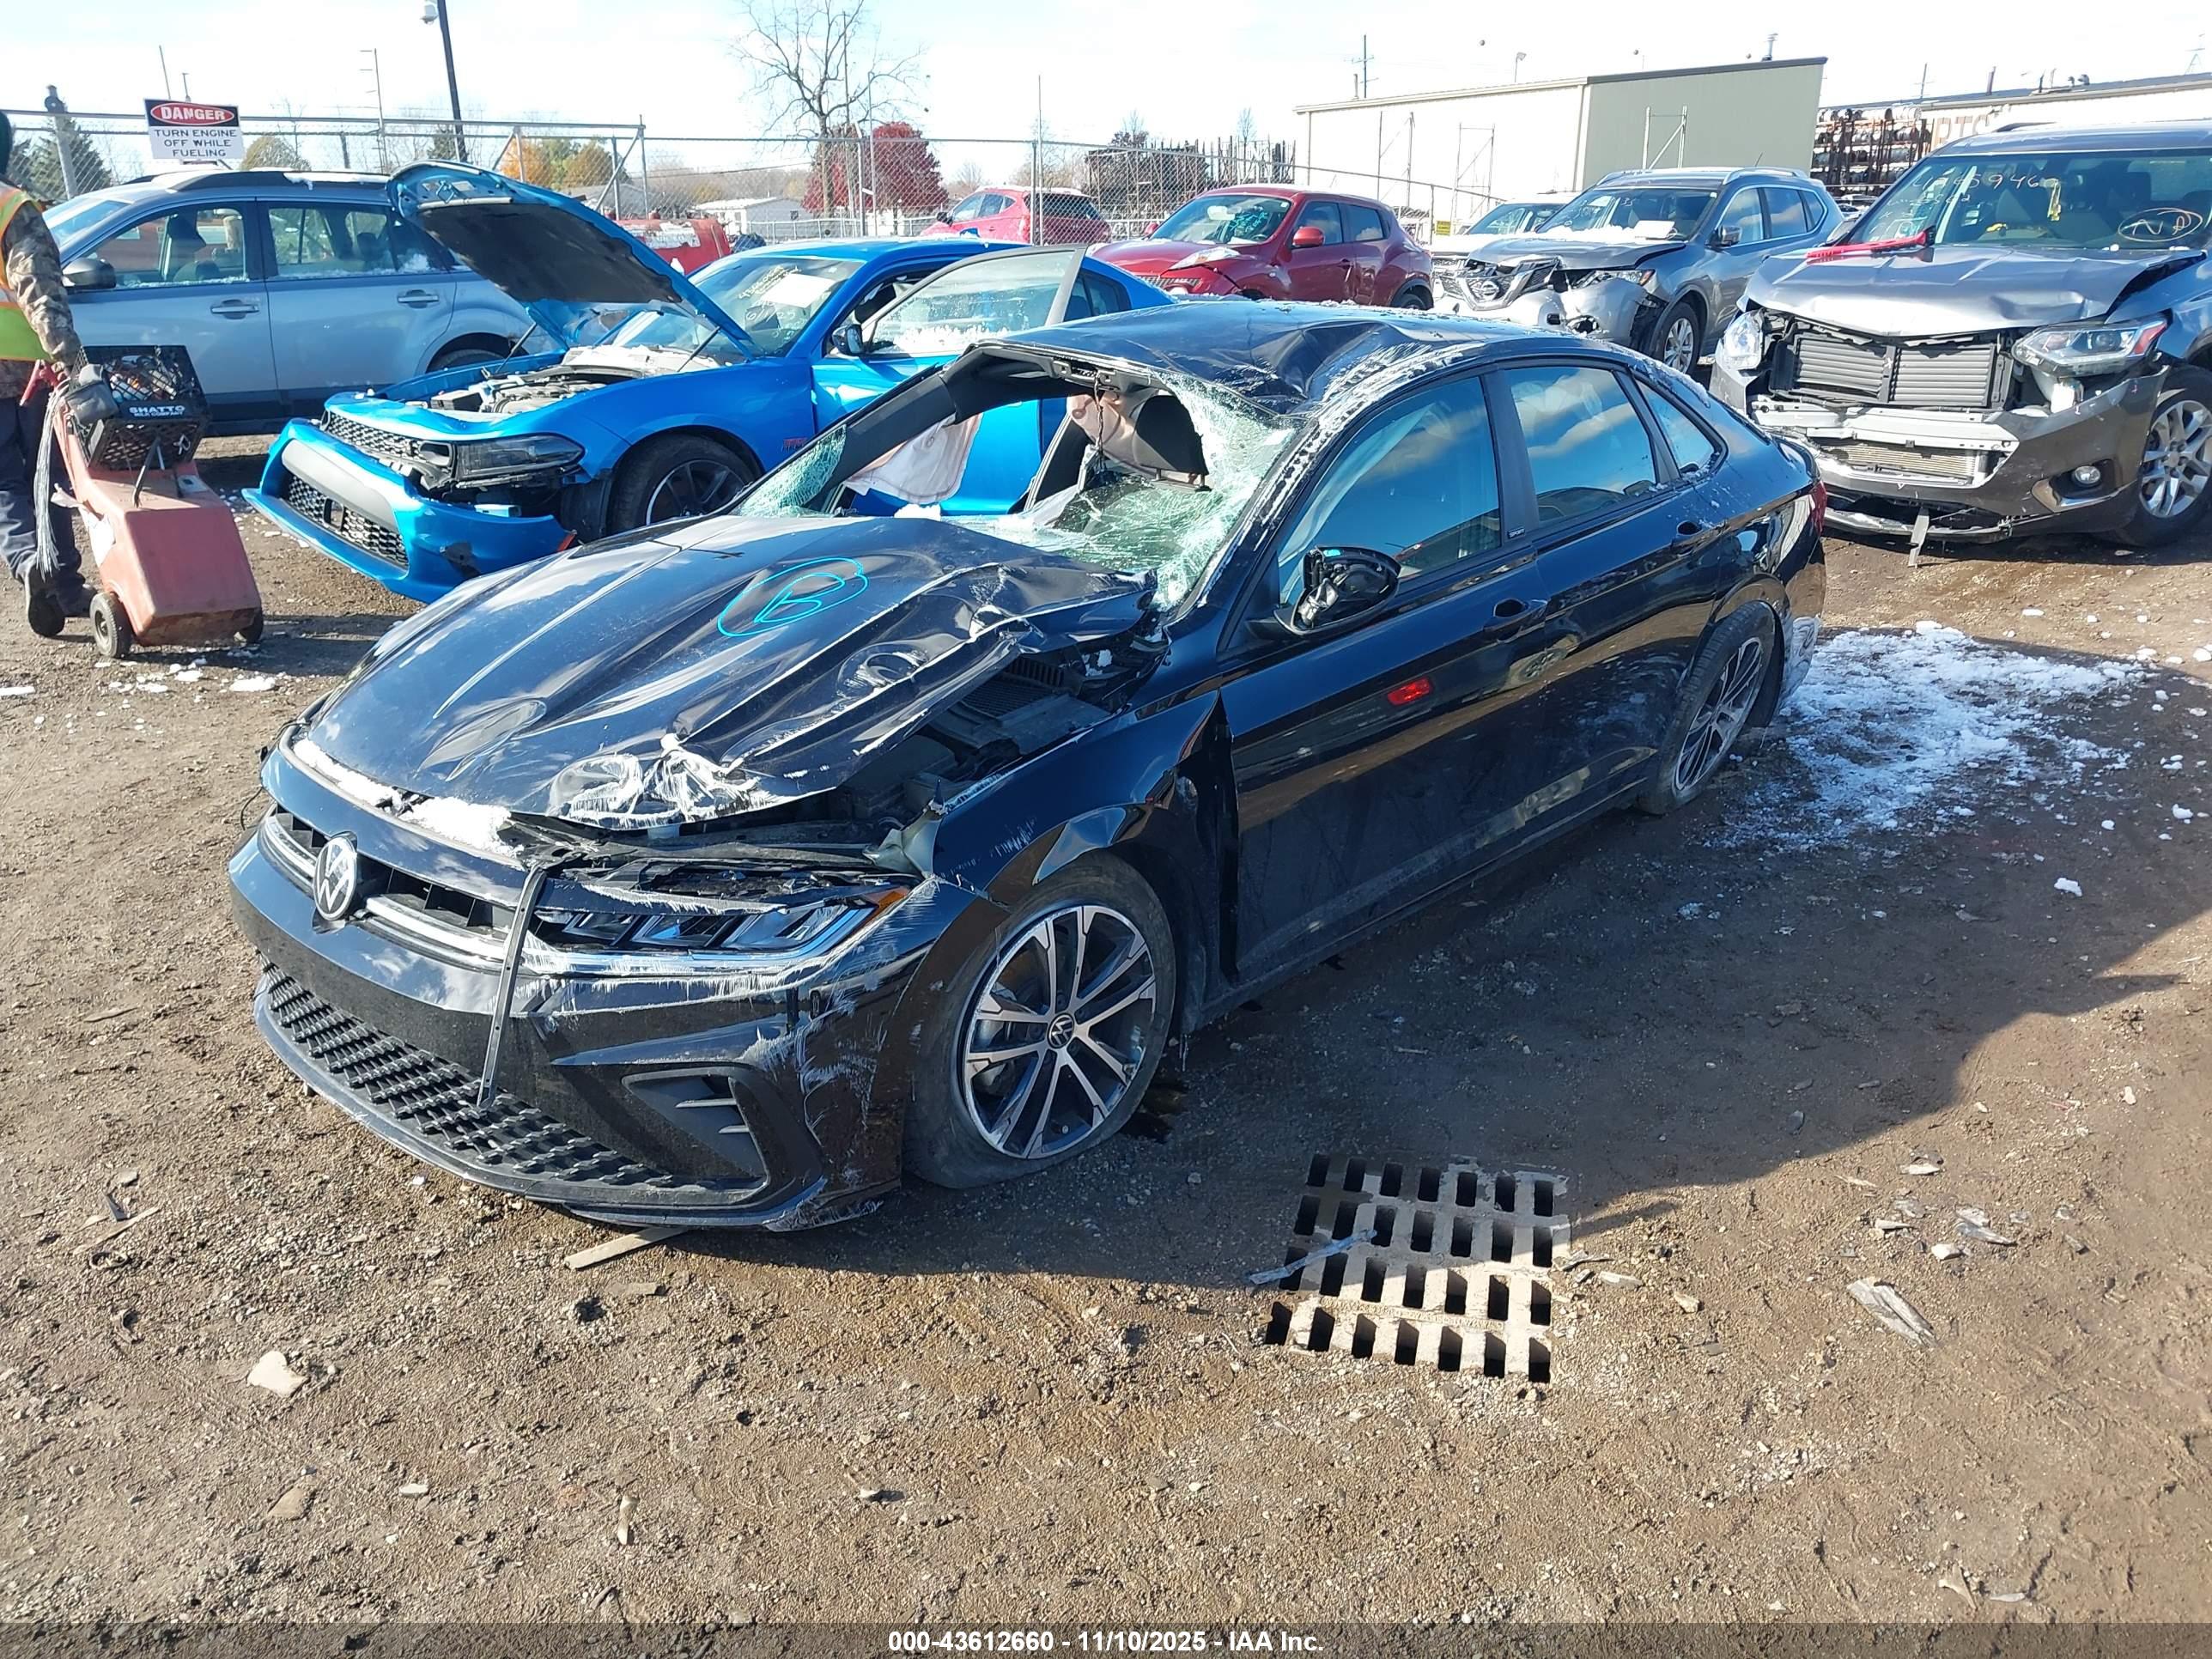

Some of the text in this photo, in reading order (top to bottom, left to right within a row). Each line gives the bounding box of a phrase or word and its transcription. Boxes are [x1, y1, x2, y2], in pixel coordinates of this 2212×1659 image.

[161, 106, 225, 120] DANGER
[155, 129, 237, 137] TURN ENGINE
[172, 149, 226, 157] FUELING
[129, 405, 185, 414] SHATTO
